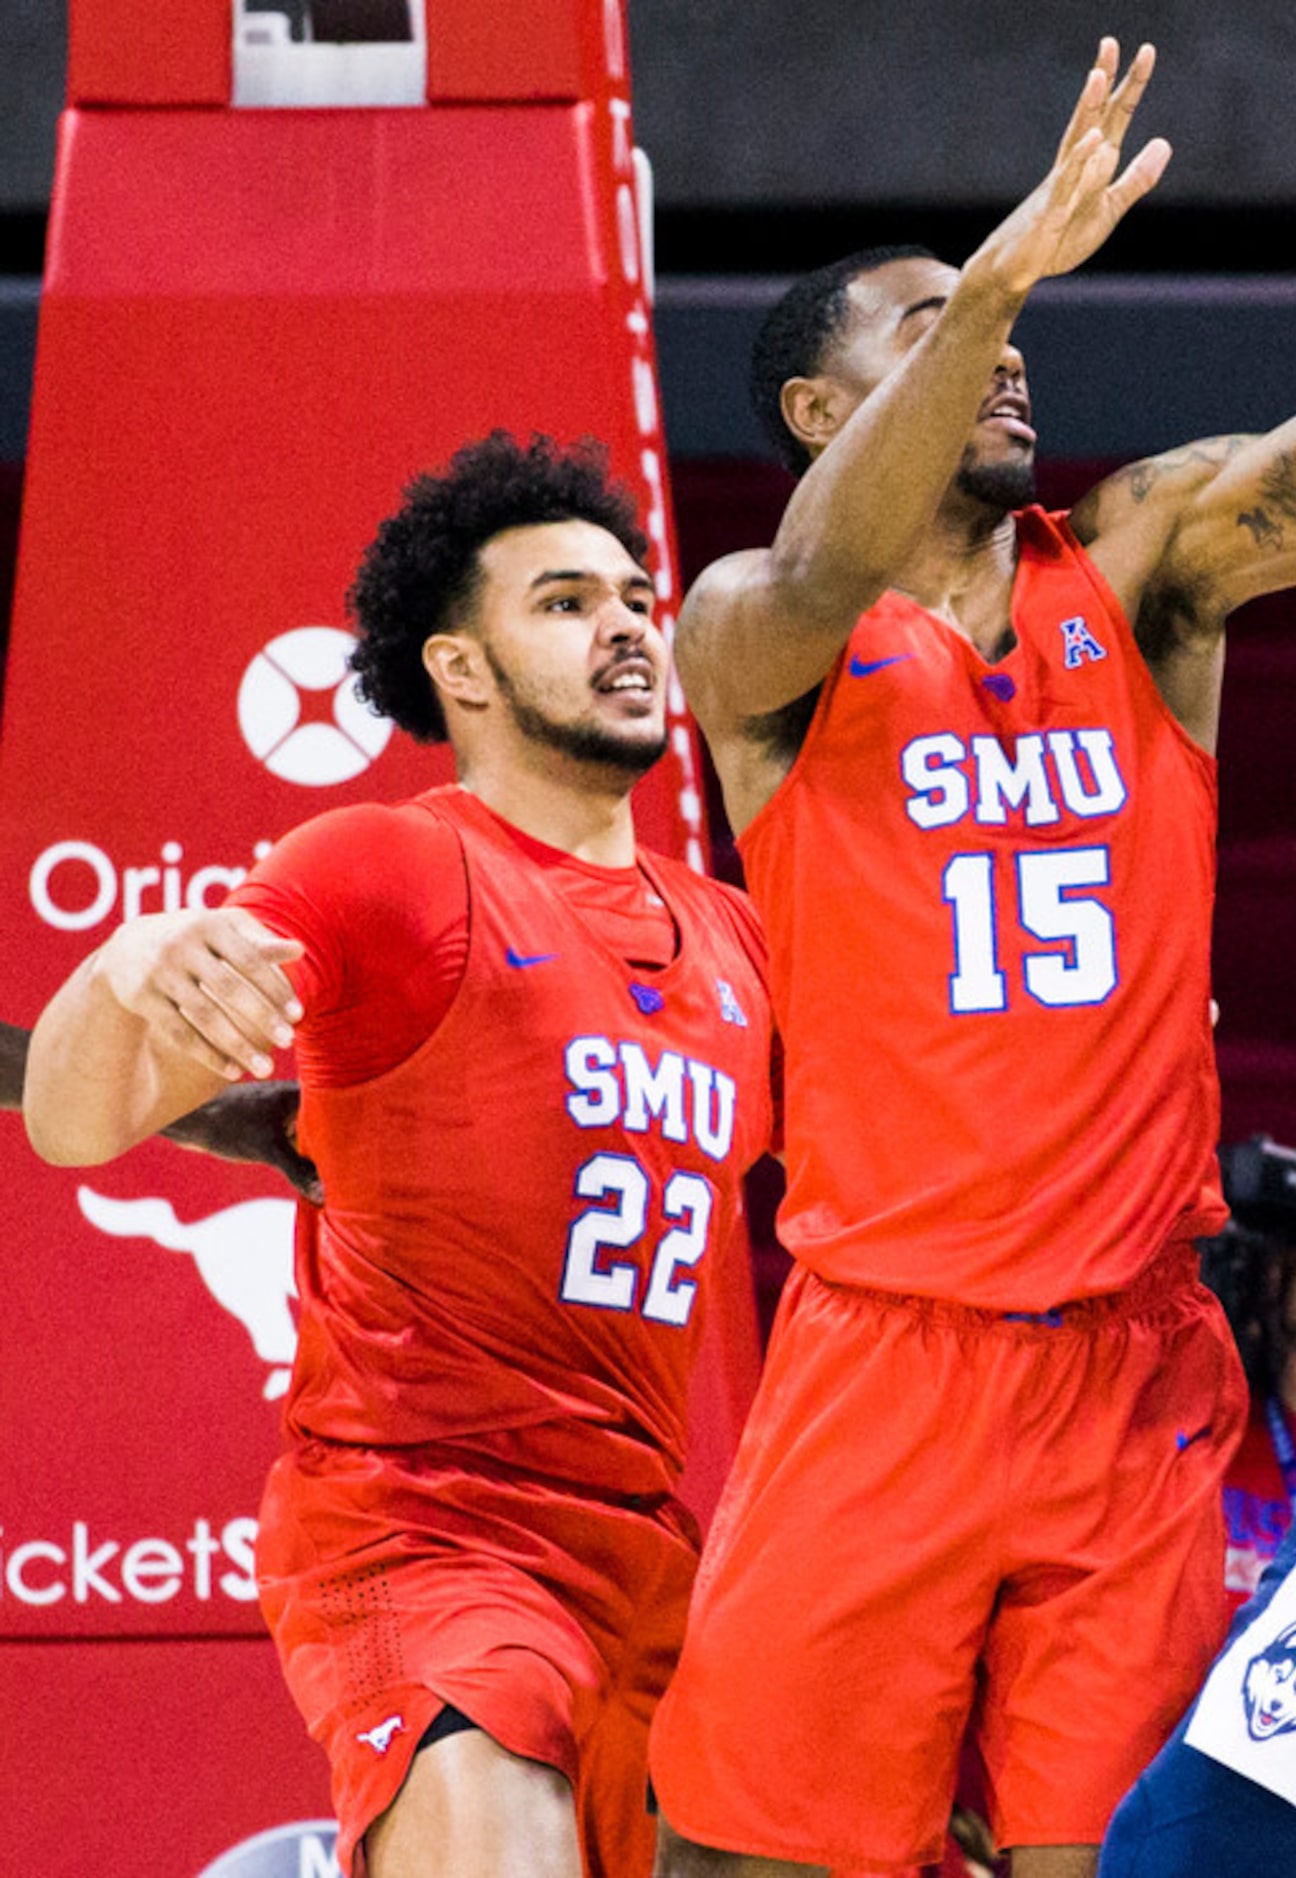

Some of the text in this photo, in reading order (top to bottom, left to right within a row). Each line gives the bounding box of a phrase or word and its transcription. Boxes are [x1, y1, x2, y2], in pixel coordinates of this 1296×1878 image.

[901, 728, 1129, 831] SMU
[28, 839, 273, 931] Ori
[942, 844, 1119, 1015] 15
[563, 1034, 737, 1164] SMU
[557, 1150, 714, 1328] 22
[0, 1517, 260, 1605] cketS
